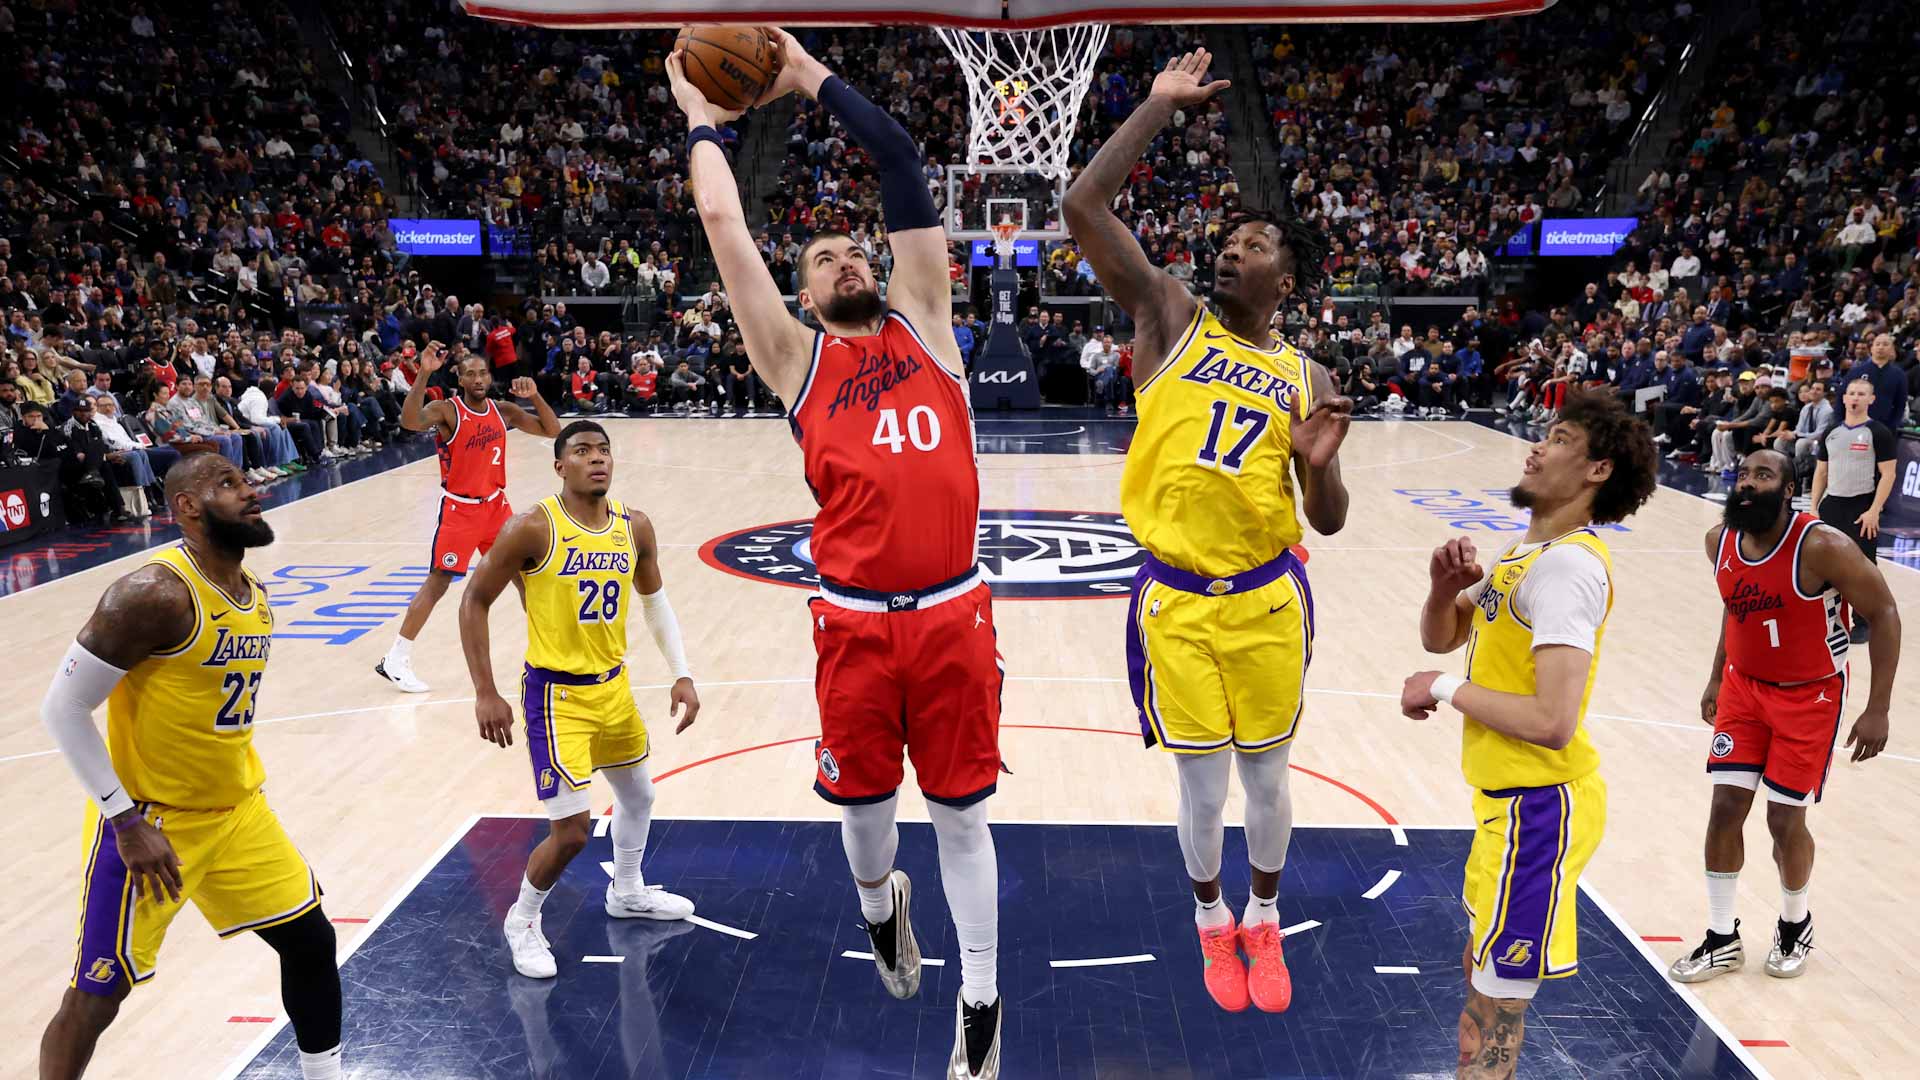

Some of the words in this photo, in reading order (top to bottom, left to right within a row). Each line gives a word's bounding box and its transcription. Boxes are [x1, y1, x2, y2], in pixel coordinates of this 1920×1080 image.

[395, 230, 476, 244] ticketmaster
[855, 347, 891, 380] Los
[1180, 345, 1300, 413] LAKERS
[828, 355, 922, 420] Angeles
[477, 423, 493, 437] Los
[872, 405, 942, 454] 40
[1196, 399, 1271, 475] 17
[491, 447, 502, 465] 2
[557, 547, 630, 574] LAKERS
[577, 579, 621, 624] 28
[892, 595, 914, 608] Clips
[1730, 578, 1760, 600] Los
[1762, 619, 1780, 648] 1
[213, 670, 263, 732] 23
